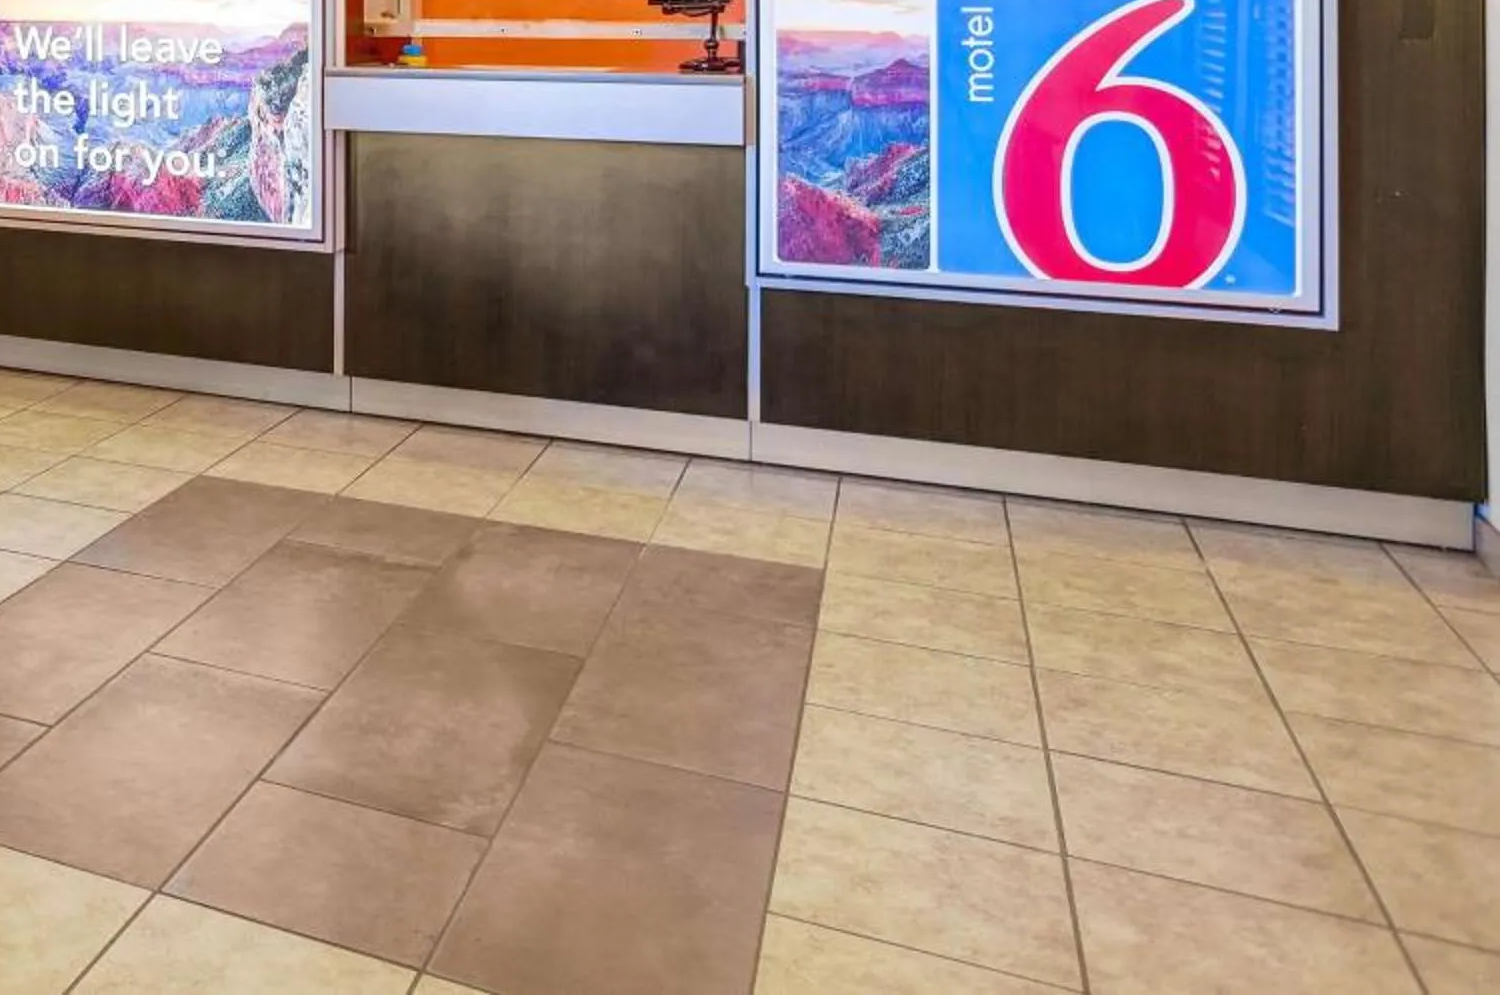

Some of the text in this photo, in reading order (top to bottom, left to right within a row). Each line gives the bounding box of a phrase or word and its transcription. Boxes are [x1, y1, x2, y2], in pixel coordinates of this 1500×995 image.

[14, 24, 222, 64] We'll leave
[960, 6, 994, 102] motel
[13, 78, 181, 127] the light
[13, 141, 60, 168] on
[74, 133, 133, 172] for
